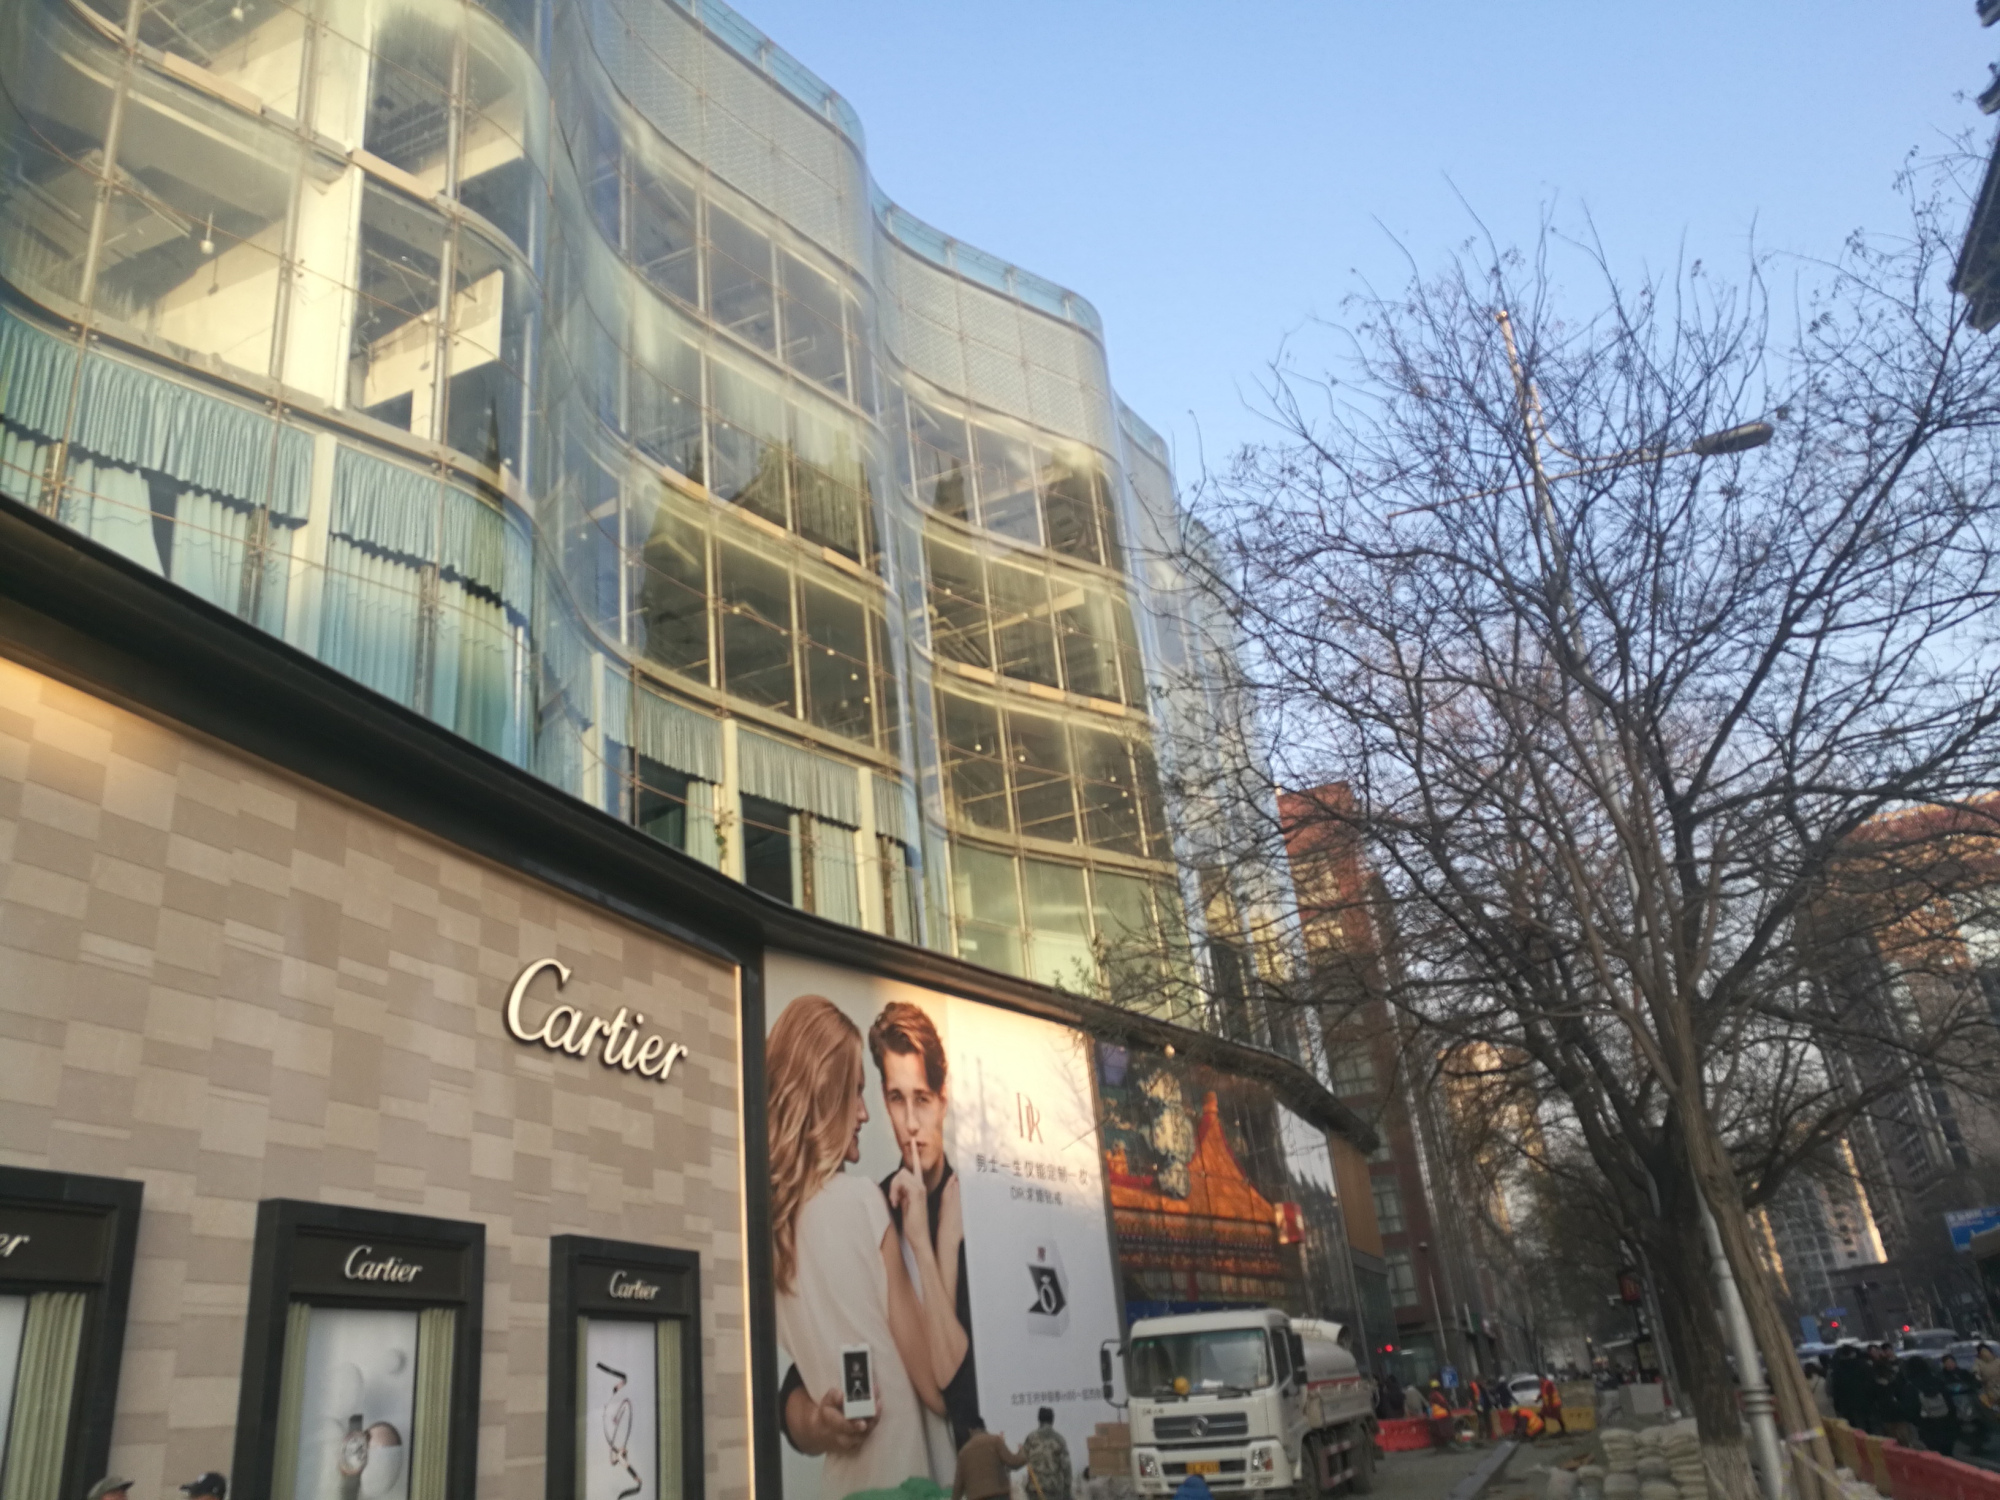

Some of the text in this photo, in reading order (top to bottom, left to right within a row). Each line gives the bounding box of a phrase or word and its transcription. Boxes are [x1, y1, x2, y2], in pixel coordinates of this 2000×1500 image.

[505, 957, 689, 1081] Cartier
[344, 1244, 423, 1283] Cartier
[609, 1269, 661, 1301] Cartier
